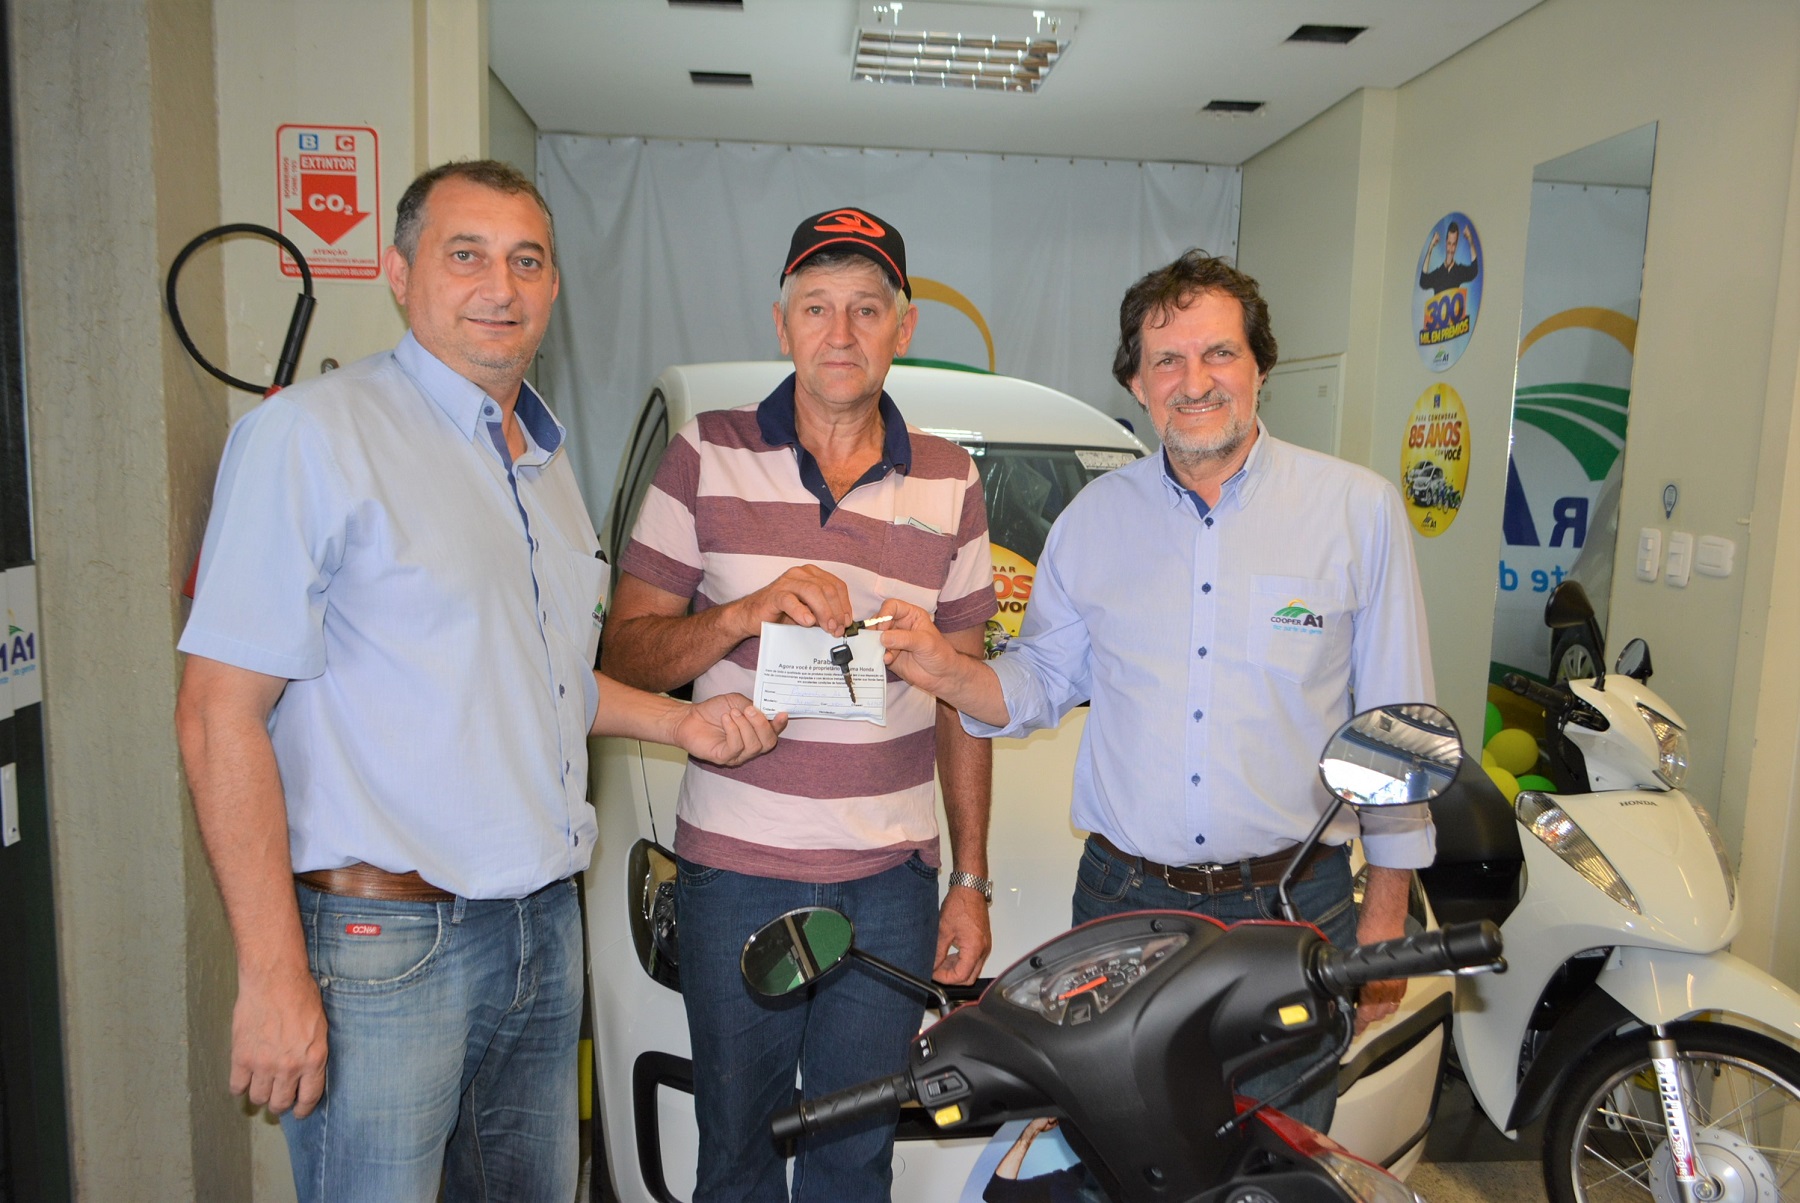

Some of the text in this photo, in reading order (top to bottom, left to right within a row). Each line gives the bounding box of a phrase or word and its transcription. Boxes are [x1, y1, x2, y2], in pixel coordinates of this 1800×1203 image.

[302, 135, 353, 150] B C
[302, 156, 355, 171] EXTINTOR
[313, 248, 348, 256] ATENÇÃO
[1426, 292, 1465, 331] 300
[1420, 318, 1469, 344] MIL EM PRÊMIOS
[1409, 421, 1462, 449] 85 ANOS
[1444, 445, 1462, 461] VOCÊ
[993, 573, 1033, 601] OS
[1270, 614, 1324, 629] COOPER A1
[11, 632, 35, 666] A1
[1619, 799, 1658, 807] HONDA
